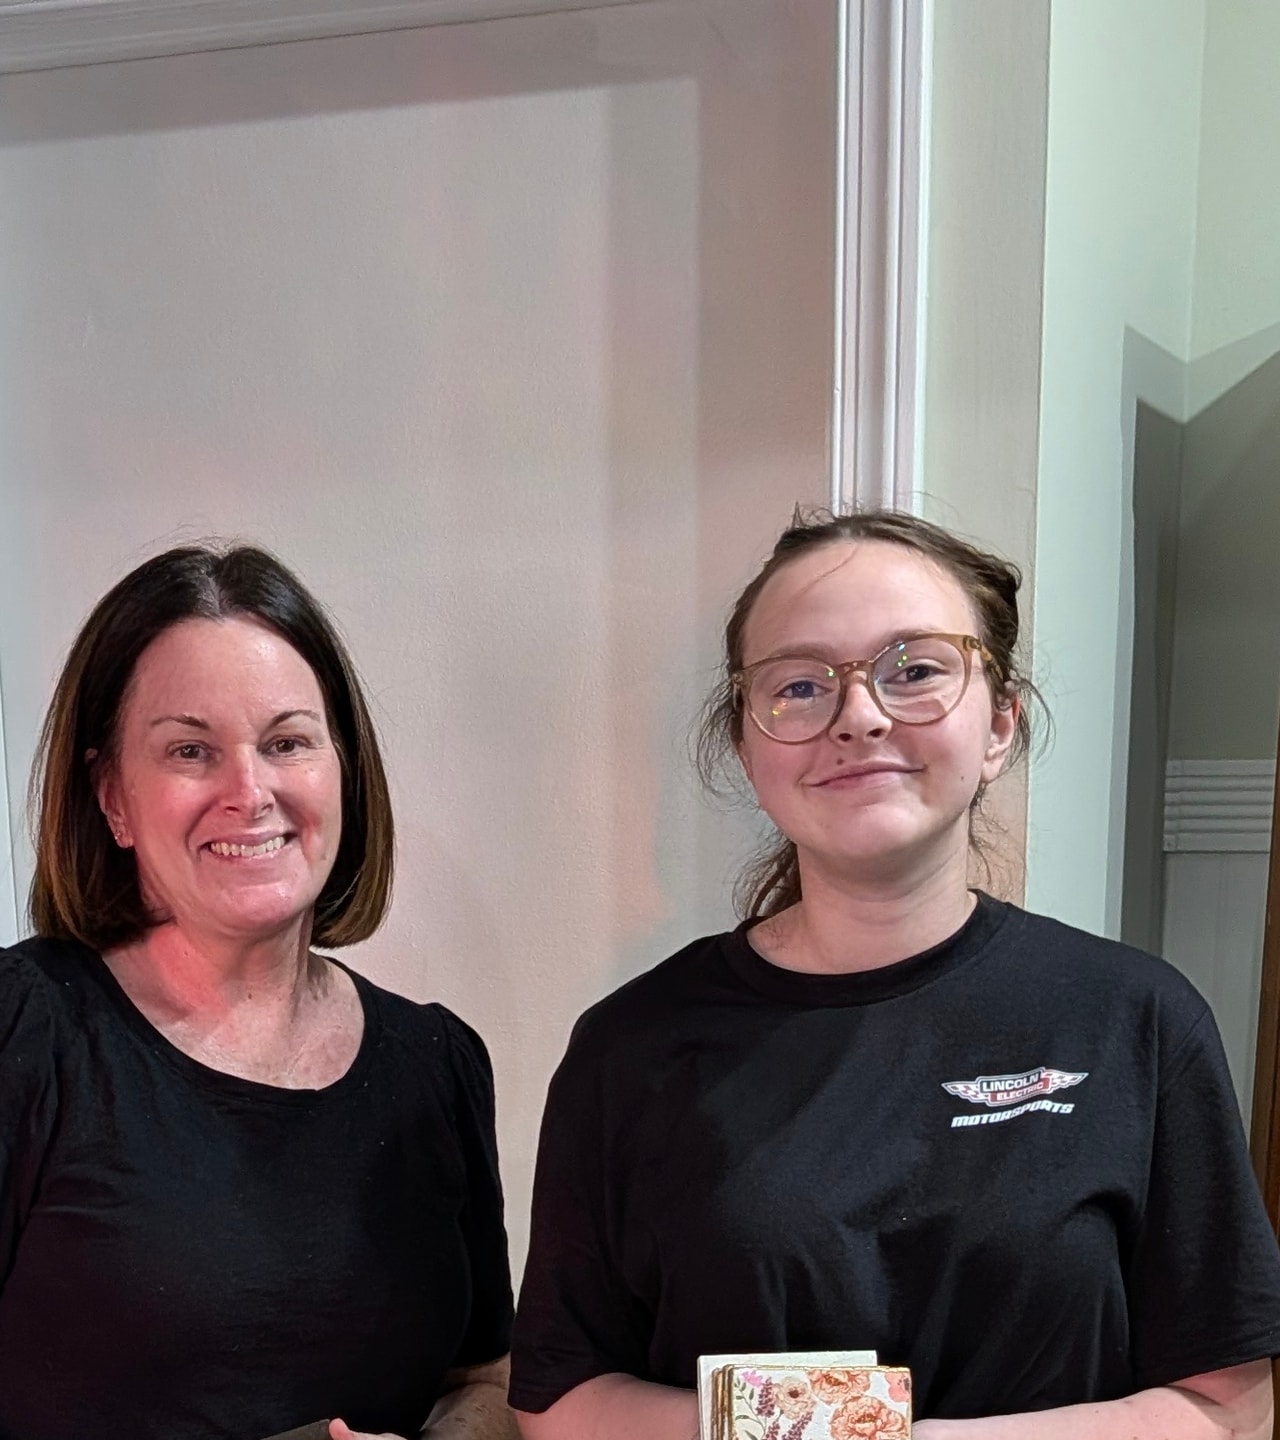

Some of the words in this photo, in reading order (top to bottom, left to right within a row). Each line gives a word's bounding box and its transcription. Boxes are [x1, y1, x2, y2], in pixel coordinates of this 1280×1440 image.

[982, 1073, 1039, 1093] LINCOLN
[996, 1082, 1045, 1102] ELECTRIC
[951, 1099, 1075, 1128] MOTORSPORTS
